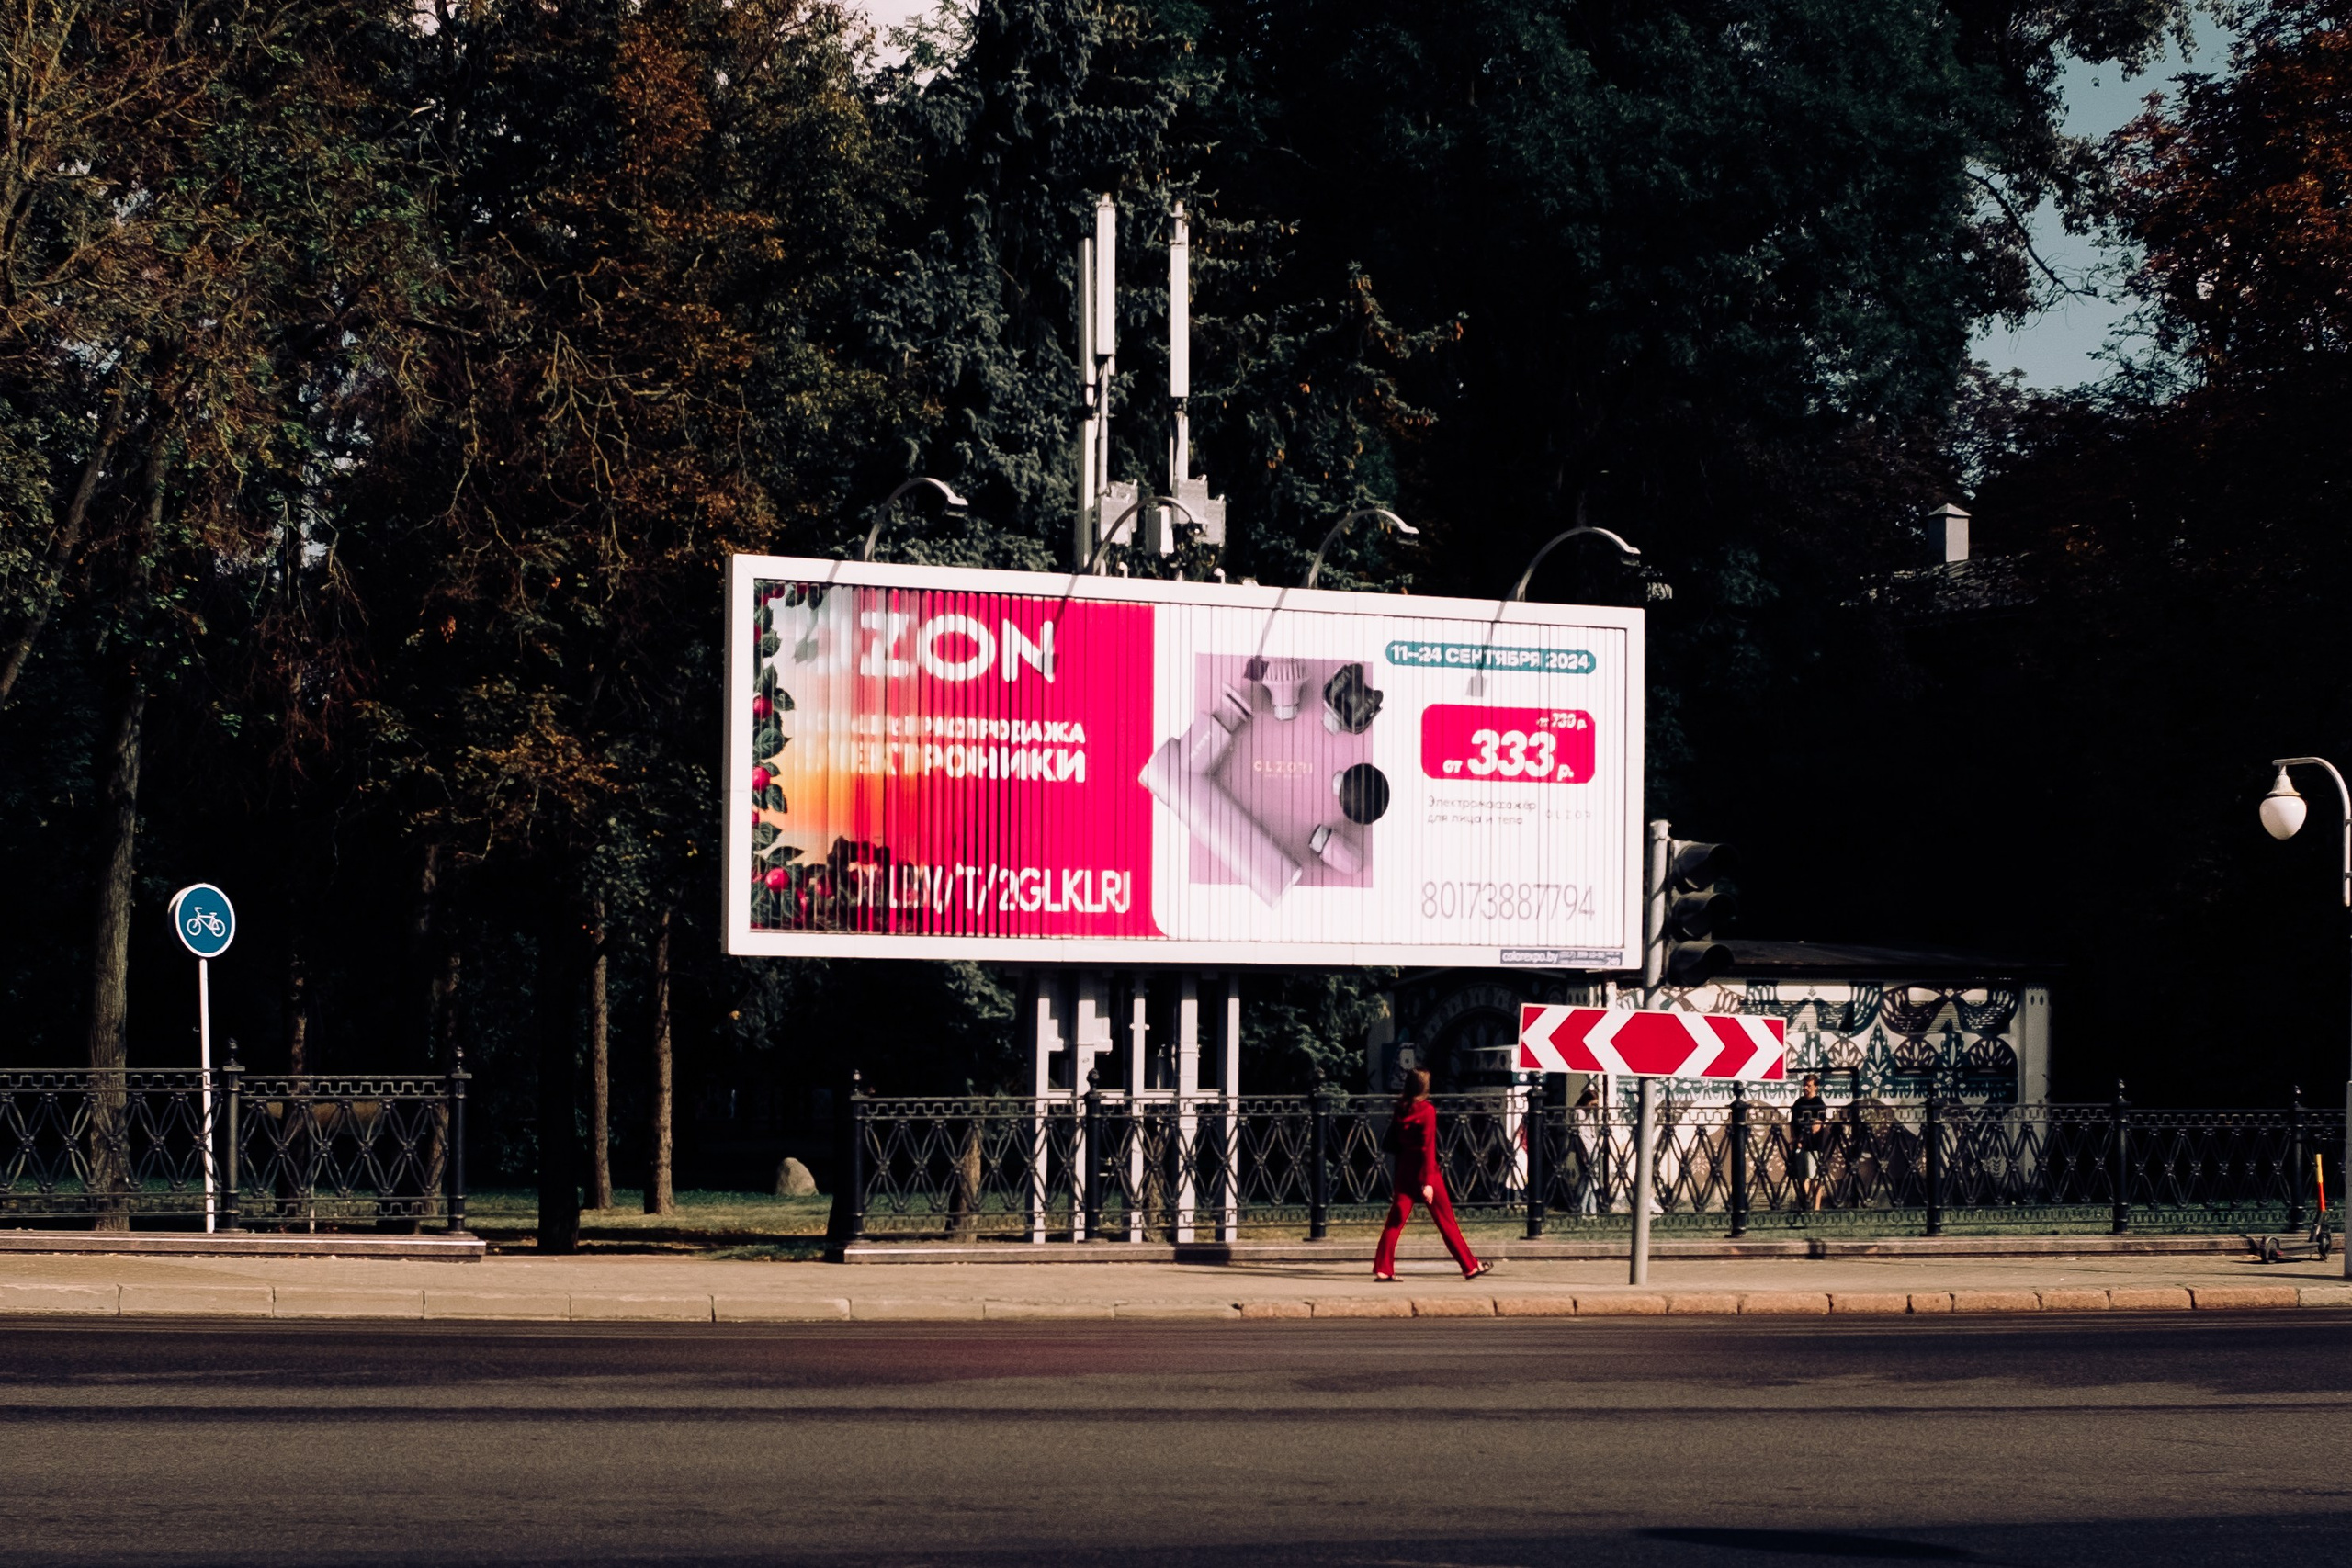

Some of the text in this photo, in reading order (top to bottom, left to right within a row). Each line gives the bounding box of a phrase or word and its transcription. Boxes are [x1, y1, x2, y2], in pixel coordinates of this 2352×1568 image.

[1445, 647, 1541, 668] СЕНТЯБРЯ
[1545, 652, 1591, 670] 2024
[1442, 728, 1575, 782] от 333 р.
[1421, 880, 1596, 921] 80173887794
